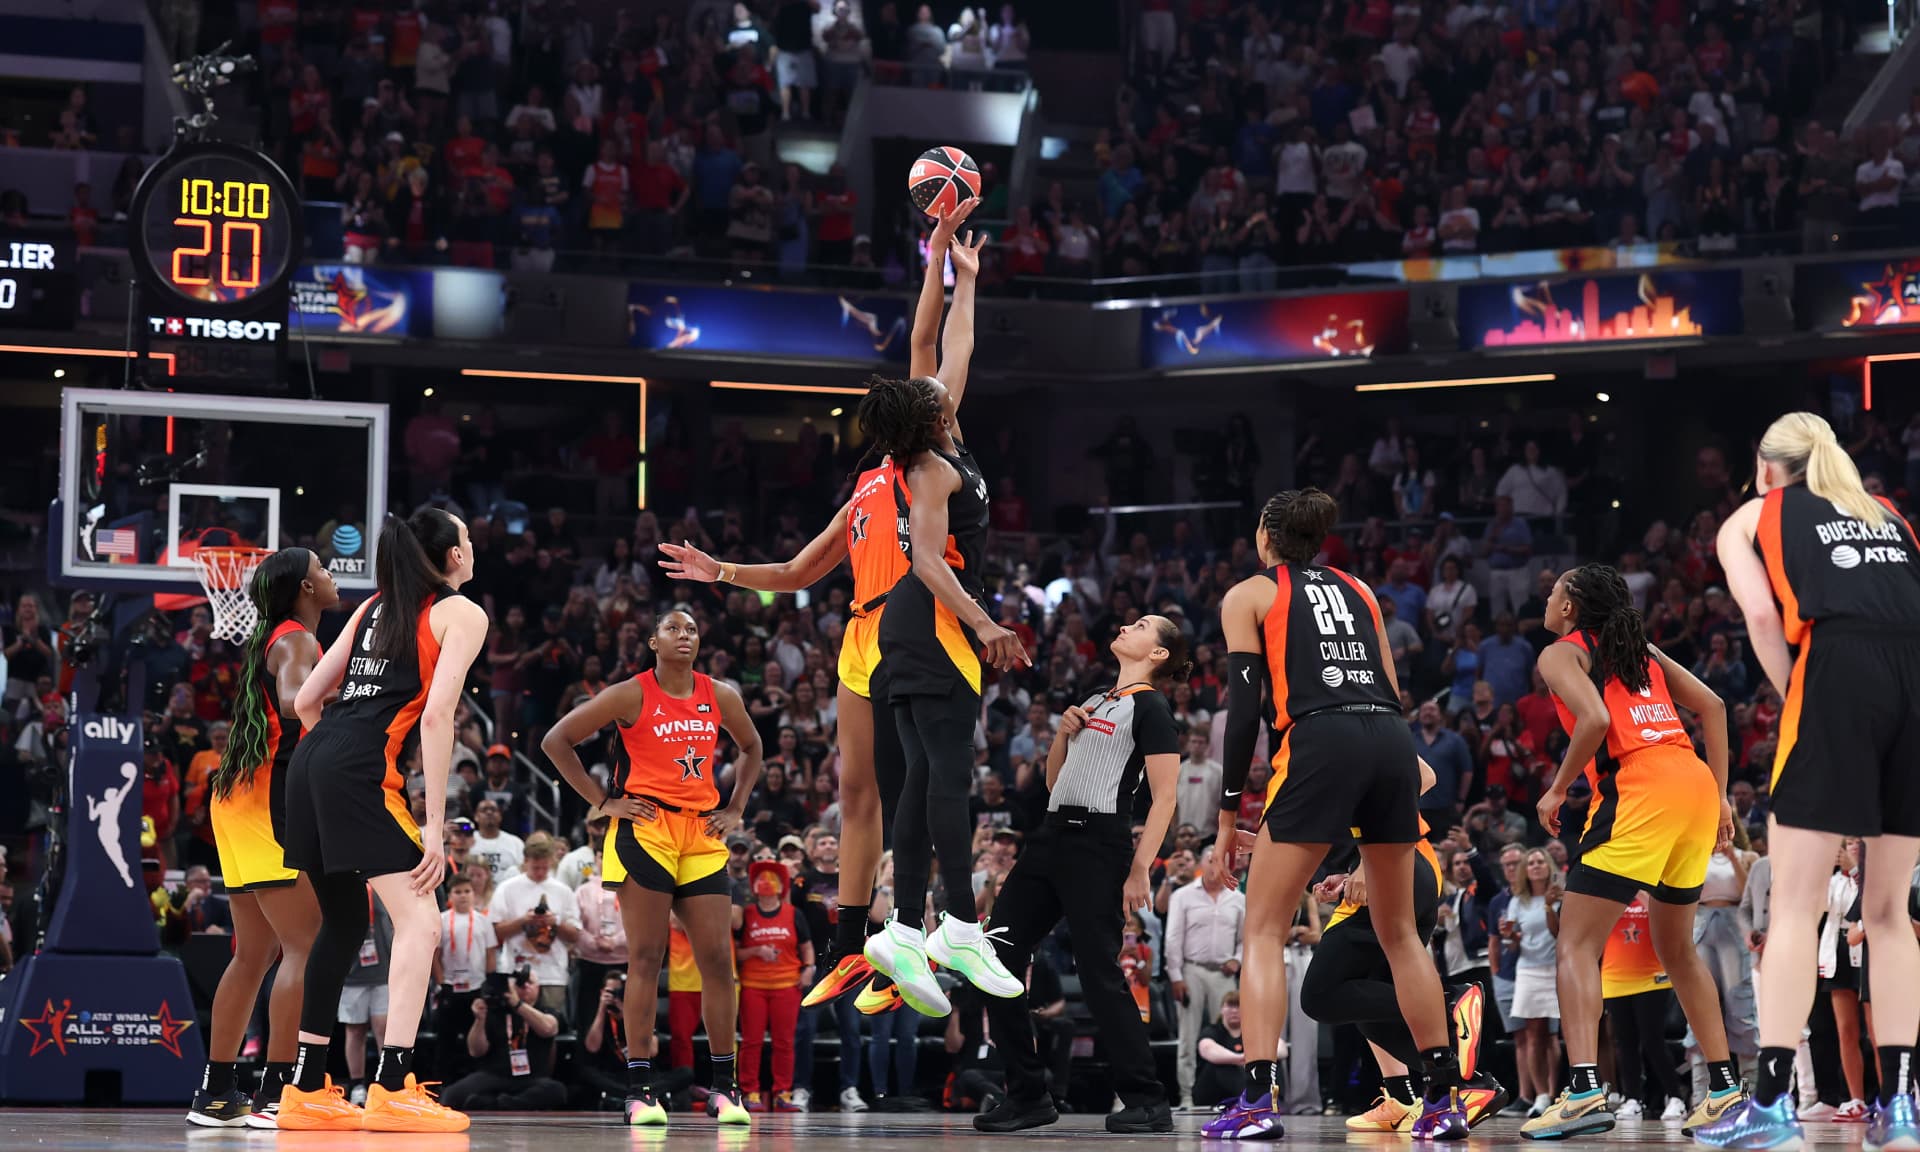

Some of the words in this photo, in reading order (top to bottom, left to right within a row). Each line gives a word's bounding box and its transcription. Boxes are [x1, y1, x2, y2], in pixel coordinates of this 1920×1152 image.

[182, 178, 269, 219] 10:00
[172, 218, 261, 288] 20
[186, 318, 281, 341] TISSOT
[1815, 520, 1902, 545] BUECKERS
[328, 557, 366, 573] AT&T
[1304, 584, 1356, 635] 24
[1319, 641, 1367, 661] COLLIER
[349, 656, 389, 676] STEWART
[1346, 669, 1375, 685] AT&T
[1629, 704, 1679, 726] MITCHELL
[84, 717, 136, 745] ally
[653, 719, 717, 737] WNBA
[91, 1012, 113, 1022] AT&T
[116, 1013, 149, 1022] WNBA
[78, 1036, 110, 1045] INDY
